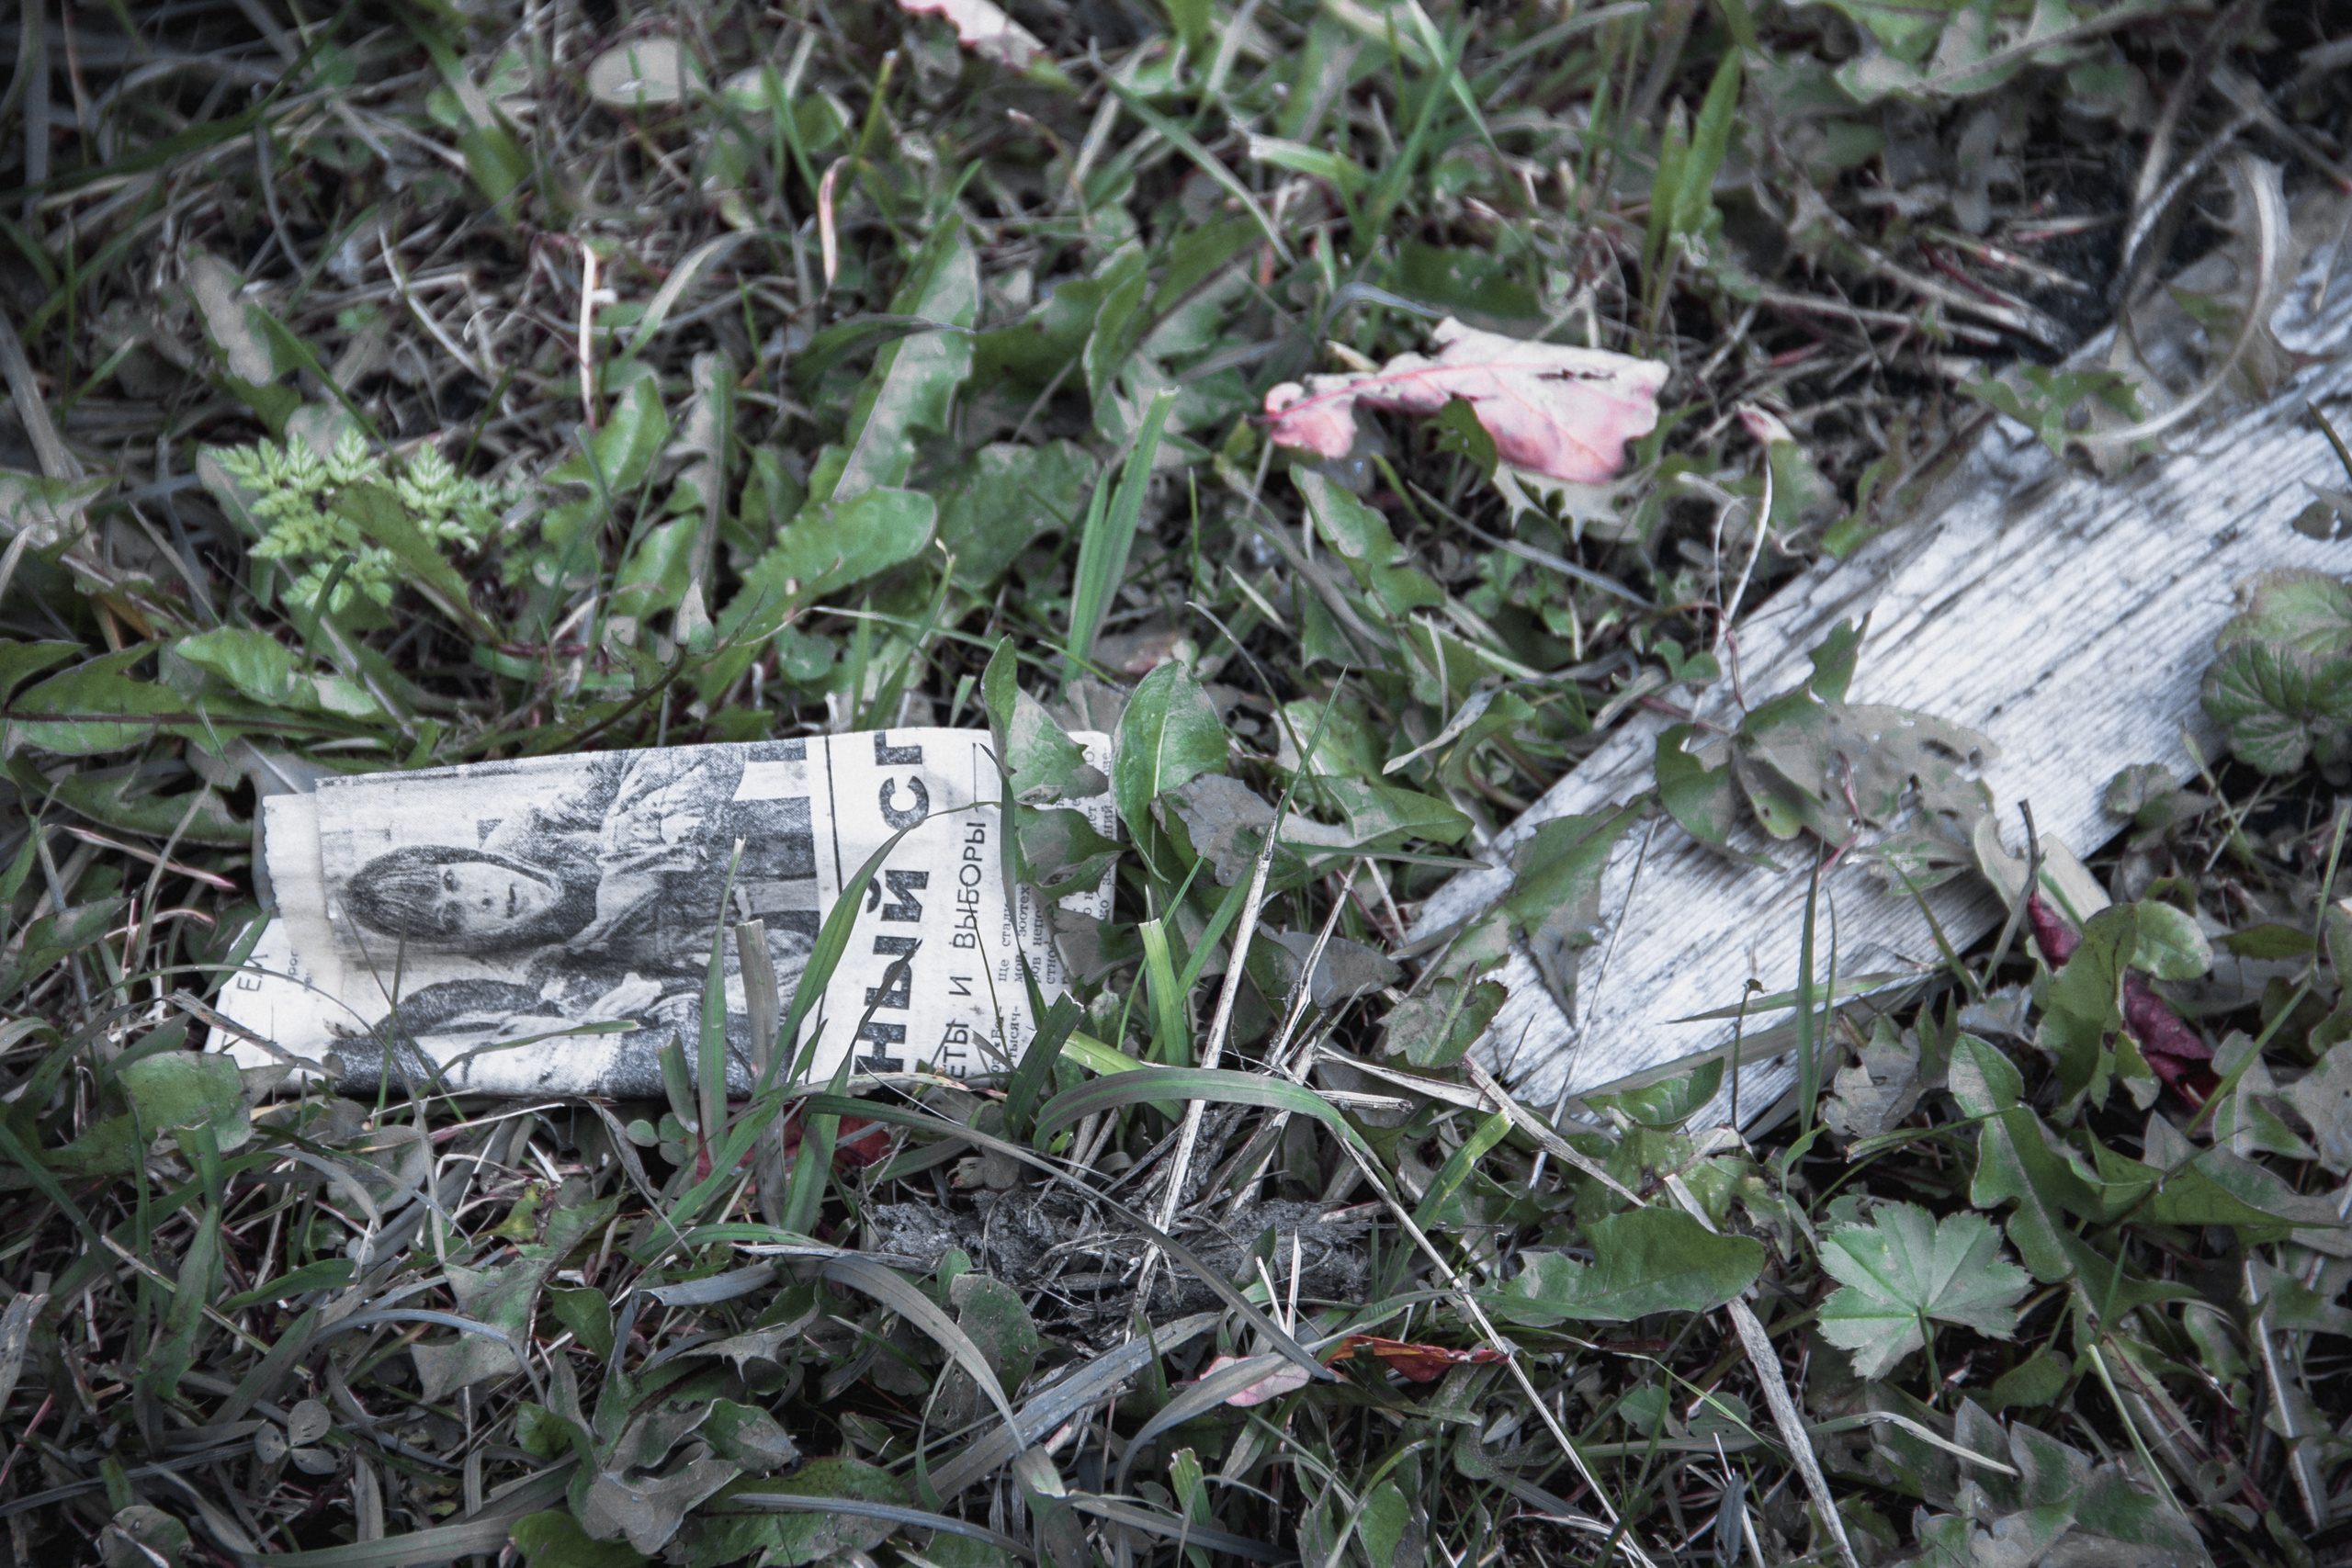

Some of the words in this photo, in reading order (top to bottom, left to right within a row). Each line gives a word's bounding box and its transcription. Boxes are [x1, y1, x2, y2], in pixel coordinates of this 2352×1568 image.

[953, 821, 987, 949] ВЫБОРЫ
[1018, 886, 1030, 937] зоотех
[948, 976, 973, 996] И
